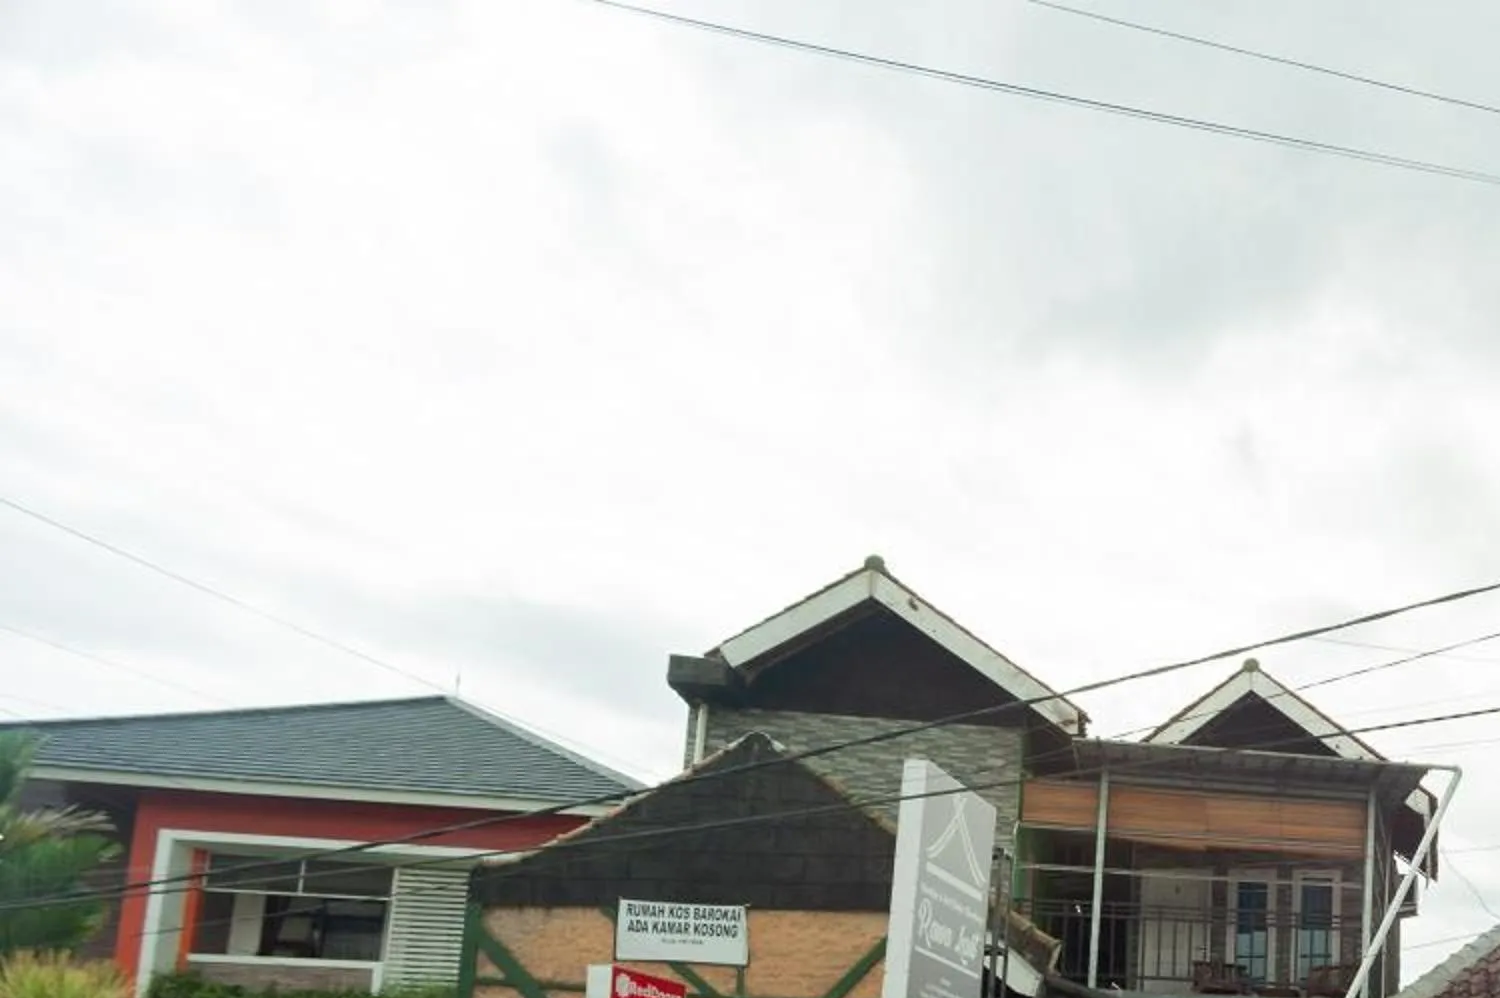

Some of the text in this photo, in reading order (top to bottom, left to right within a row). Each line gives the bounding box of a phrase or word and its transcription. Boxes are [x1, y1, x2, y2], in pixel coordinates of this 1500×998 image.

[667, 906, 691, 920] KOS
[627, 919, 649, 933] ADA
[693, 922, 739, 938] KOSONG
